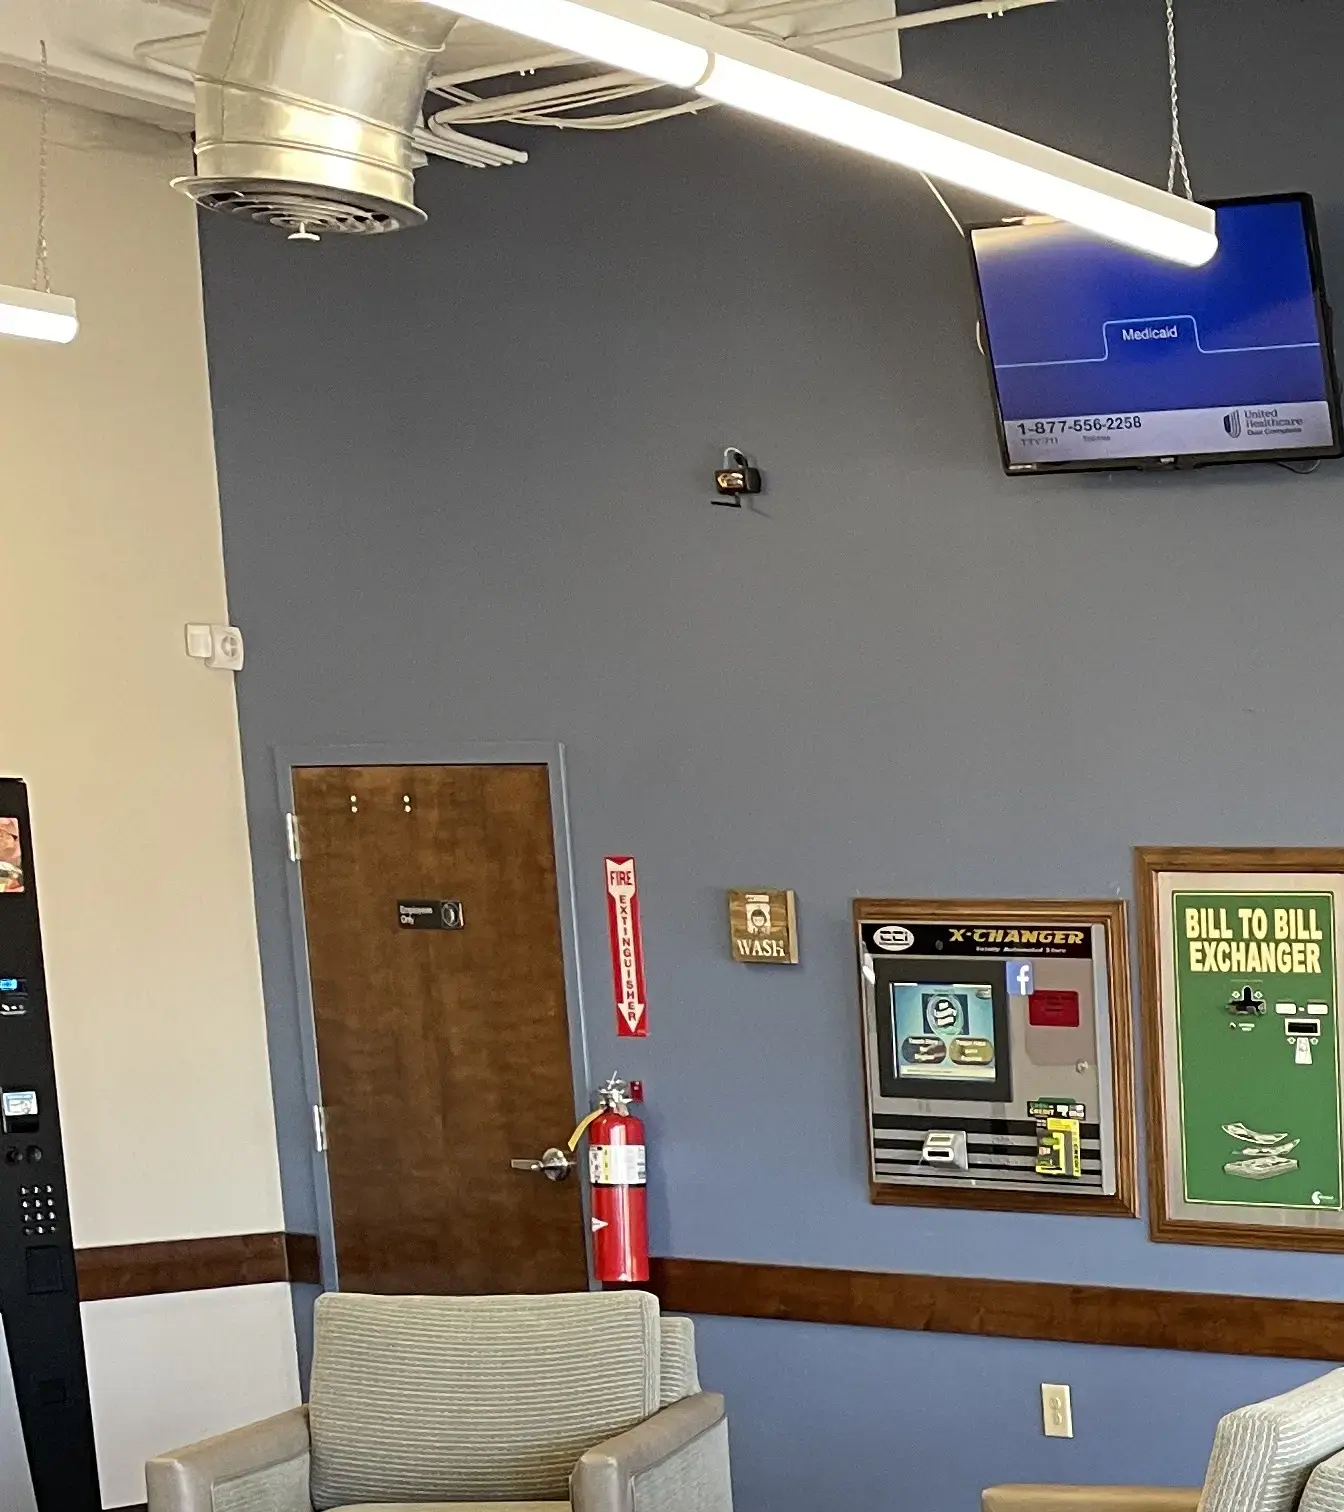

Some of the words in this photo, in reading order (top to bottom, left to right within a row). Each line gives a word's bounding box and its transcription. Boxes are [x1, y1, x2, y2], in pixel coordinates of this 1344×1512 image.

[1122, 326, 1177, 341] Medicaid
[1244, 408, 1278, 419] United
[1017, 416, 1142, 436] 1-877-556-2258
[610, 870, 633, 886] FIRE
[1185, 908, 1233, 940] BILL
[1238, 908, 1268, 940] TO
[1274, 908, 1323, 941] BILL
[948, 928, 1085, 944] X-CHANGER
[737, 939, 785, 957] WASH
[1189, 940, 1322, 974] EXCHANGER
[619, 895, 636, 1021] EXTINGUISHER
